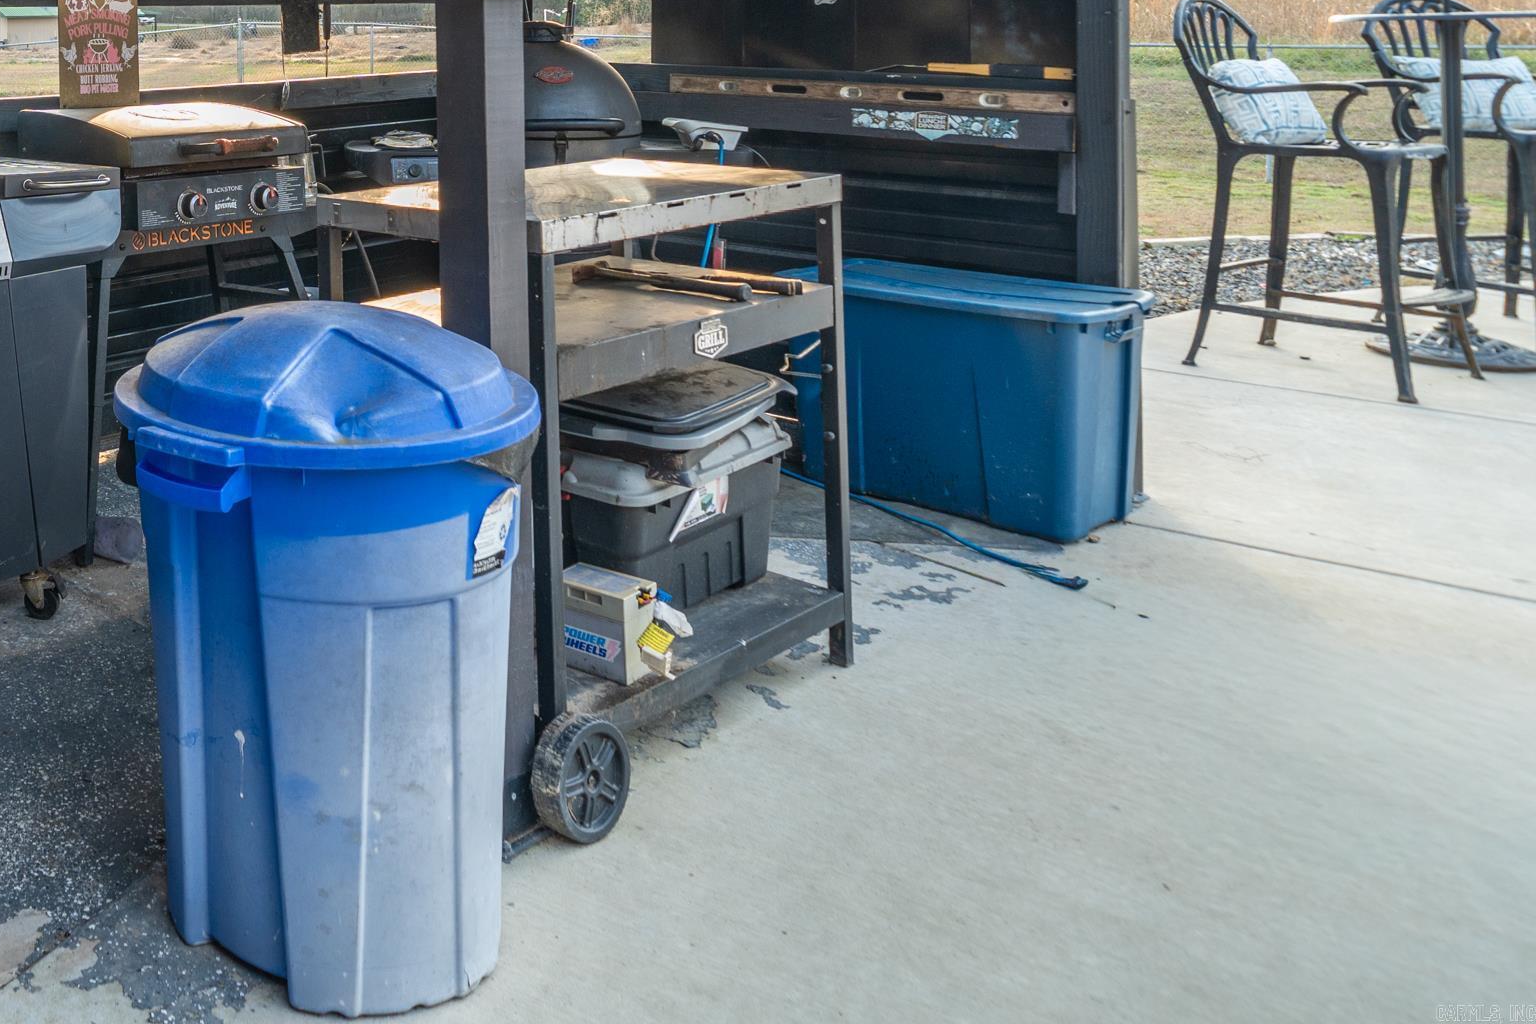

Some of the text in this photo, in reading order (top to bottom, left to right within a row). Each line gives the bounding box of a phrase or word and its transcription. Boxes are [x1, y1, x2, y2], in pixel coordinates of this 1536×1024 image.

[64, 7, 131, 27] MEAT SMOKING
[68, 23, 129, 40] PORK PULLING
[76, 63, 123, 73] CHICKEN JERKING
[206, 185, 244, 194] BLACKSTONE
[148, 220, 255, 247] BLACKSTONE
[698, 330, 725, 350] GRILL
